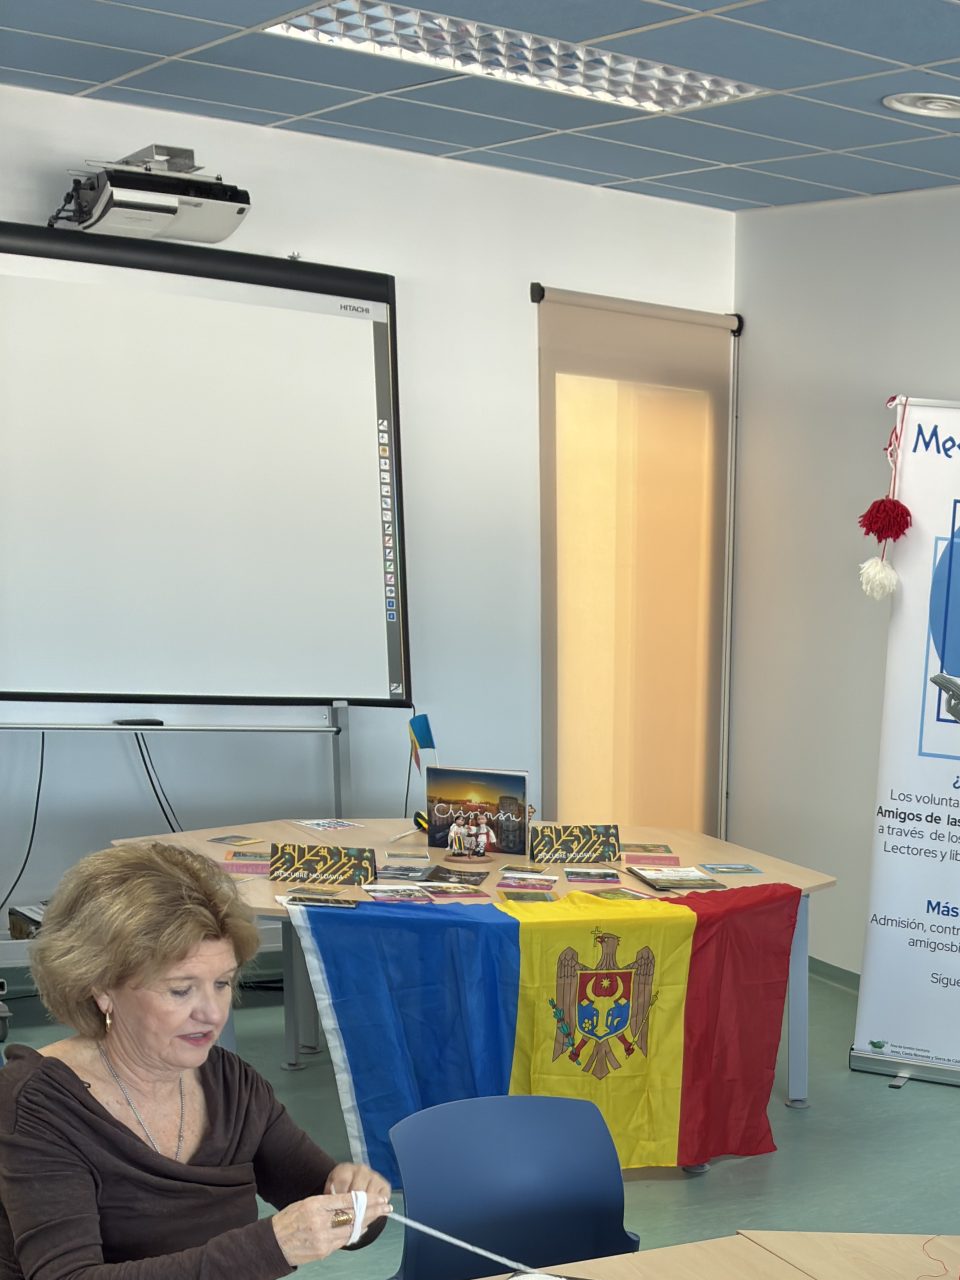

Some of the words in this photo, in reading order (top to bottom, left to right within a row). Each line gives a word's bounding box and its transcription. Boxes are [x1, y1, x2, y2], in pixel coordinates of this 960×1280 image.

[339, 303, 370, 314] HITACHI
[890, 788, 913, 803] Los
[876, 805, 923, 823] Amigos
[925, 812, 942, 825] de
[878, 824, 885, 834] a
[887, 825, 924, 840] través
[929, 830, 945, 842] de
[883, 841, 938, 859] Lectores
[939, 850, 947, 863] y
[926, 899, 960, 918] Más
[870, 913, 927, 933] Admisión,
